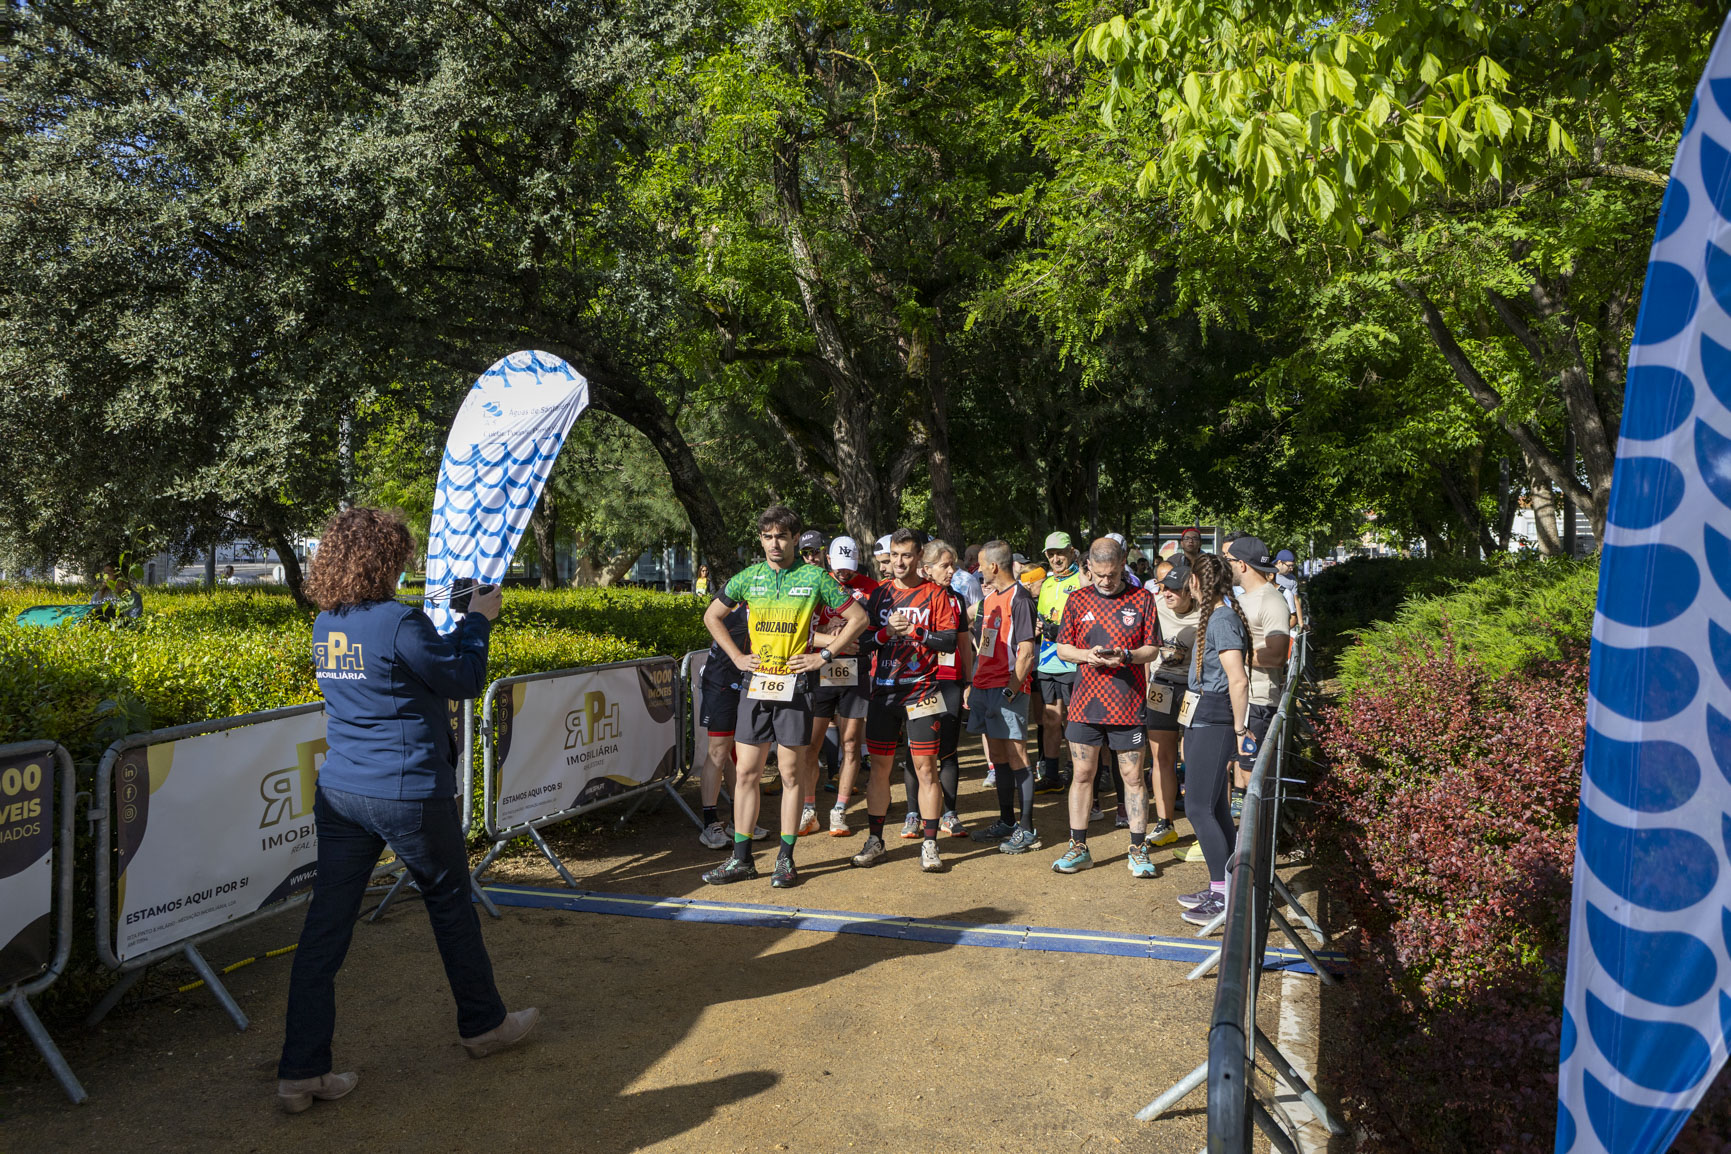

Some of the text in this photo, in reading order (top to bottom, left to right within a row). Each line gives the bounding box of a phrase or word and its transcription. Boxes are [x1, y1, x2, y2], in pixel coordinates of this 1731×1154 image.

[839, 546, 852, 557] NY
[755, 621, 798, 634] CRUZADOS
[316, 671, 367, 680] MOBILIÁRIA
[828, 667, 850, 678] 166
[760, 680, 785, 692] 186
[0, 764, 42, 796] 00
[502, 782, 562, 805] ESTAMOS AQUI POR SI
[0, 798, 41, 825] VEIS
[0, 822, 41, 844] IADOS
[262, 823, 315, 851] IMOBI
[290, 841, 310, 855] REAL
[126, 877, 249, 925] ESTAMOS AQUI POR SI
